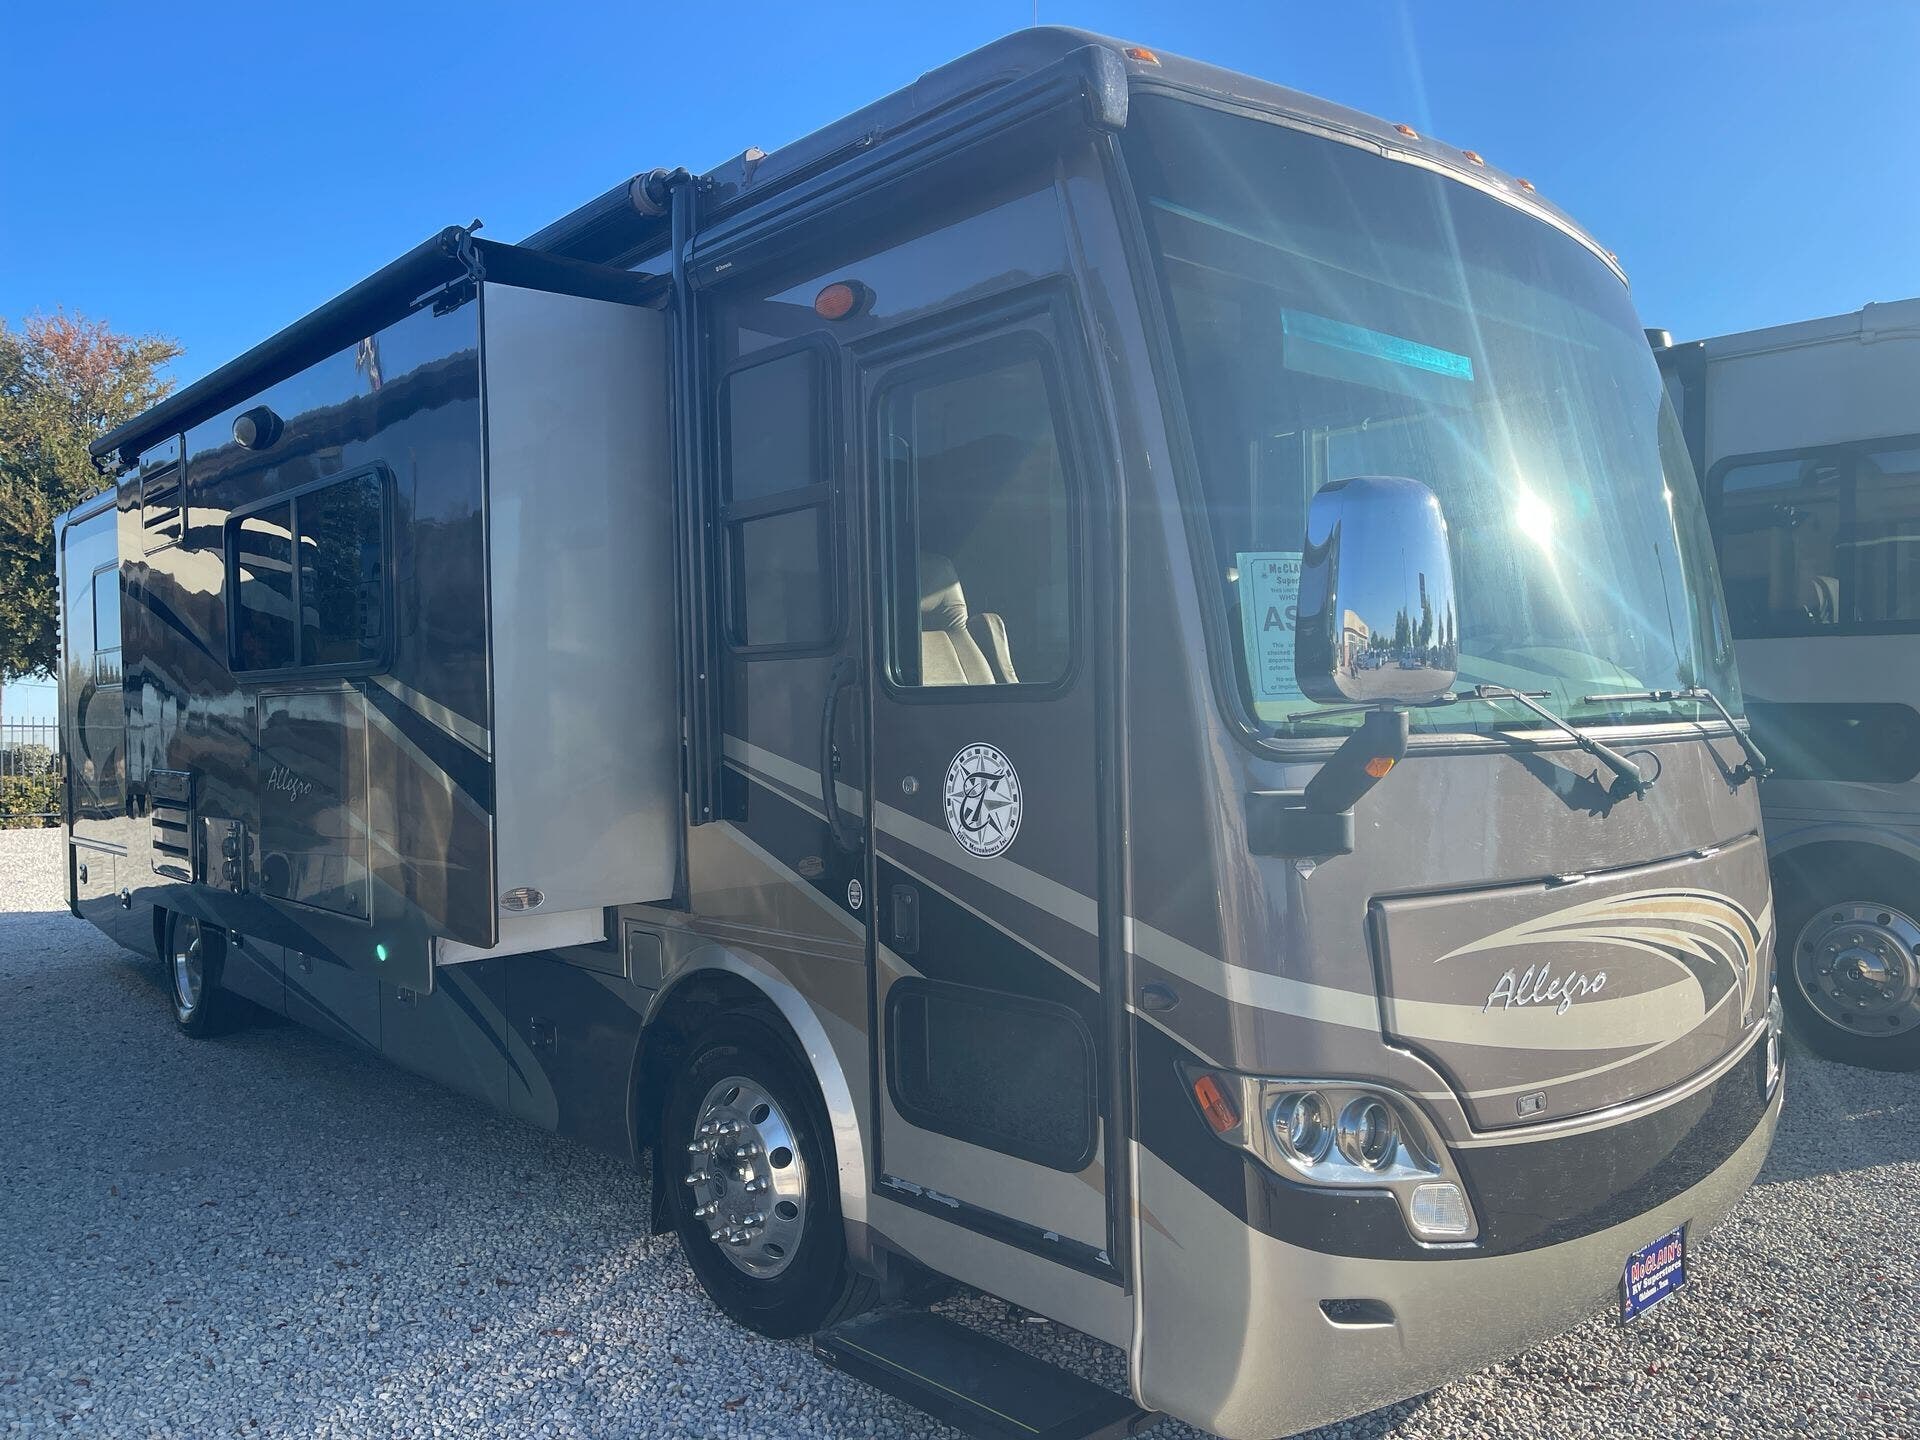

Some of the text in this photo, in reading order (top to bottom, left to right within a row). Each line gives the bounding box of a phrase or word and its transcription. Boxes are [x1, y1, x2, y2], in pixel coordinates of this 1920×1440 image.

[1269, 563, 1300, 574] McCLA
[1276, 577, 1299, 586] Super
[266, 766, 313, 802] Allegro
[1482, 962, 1608, 1015] Allegro
